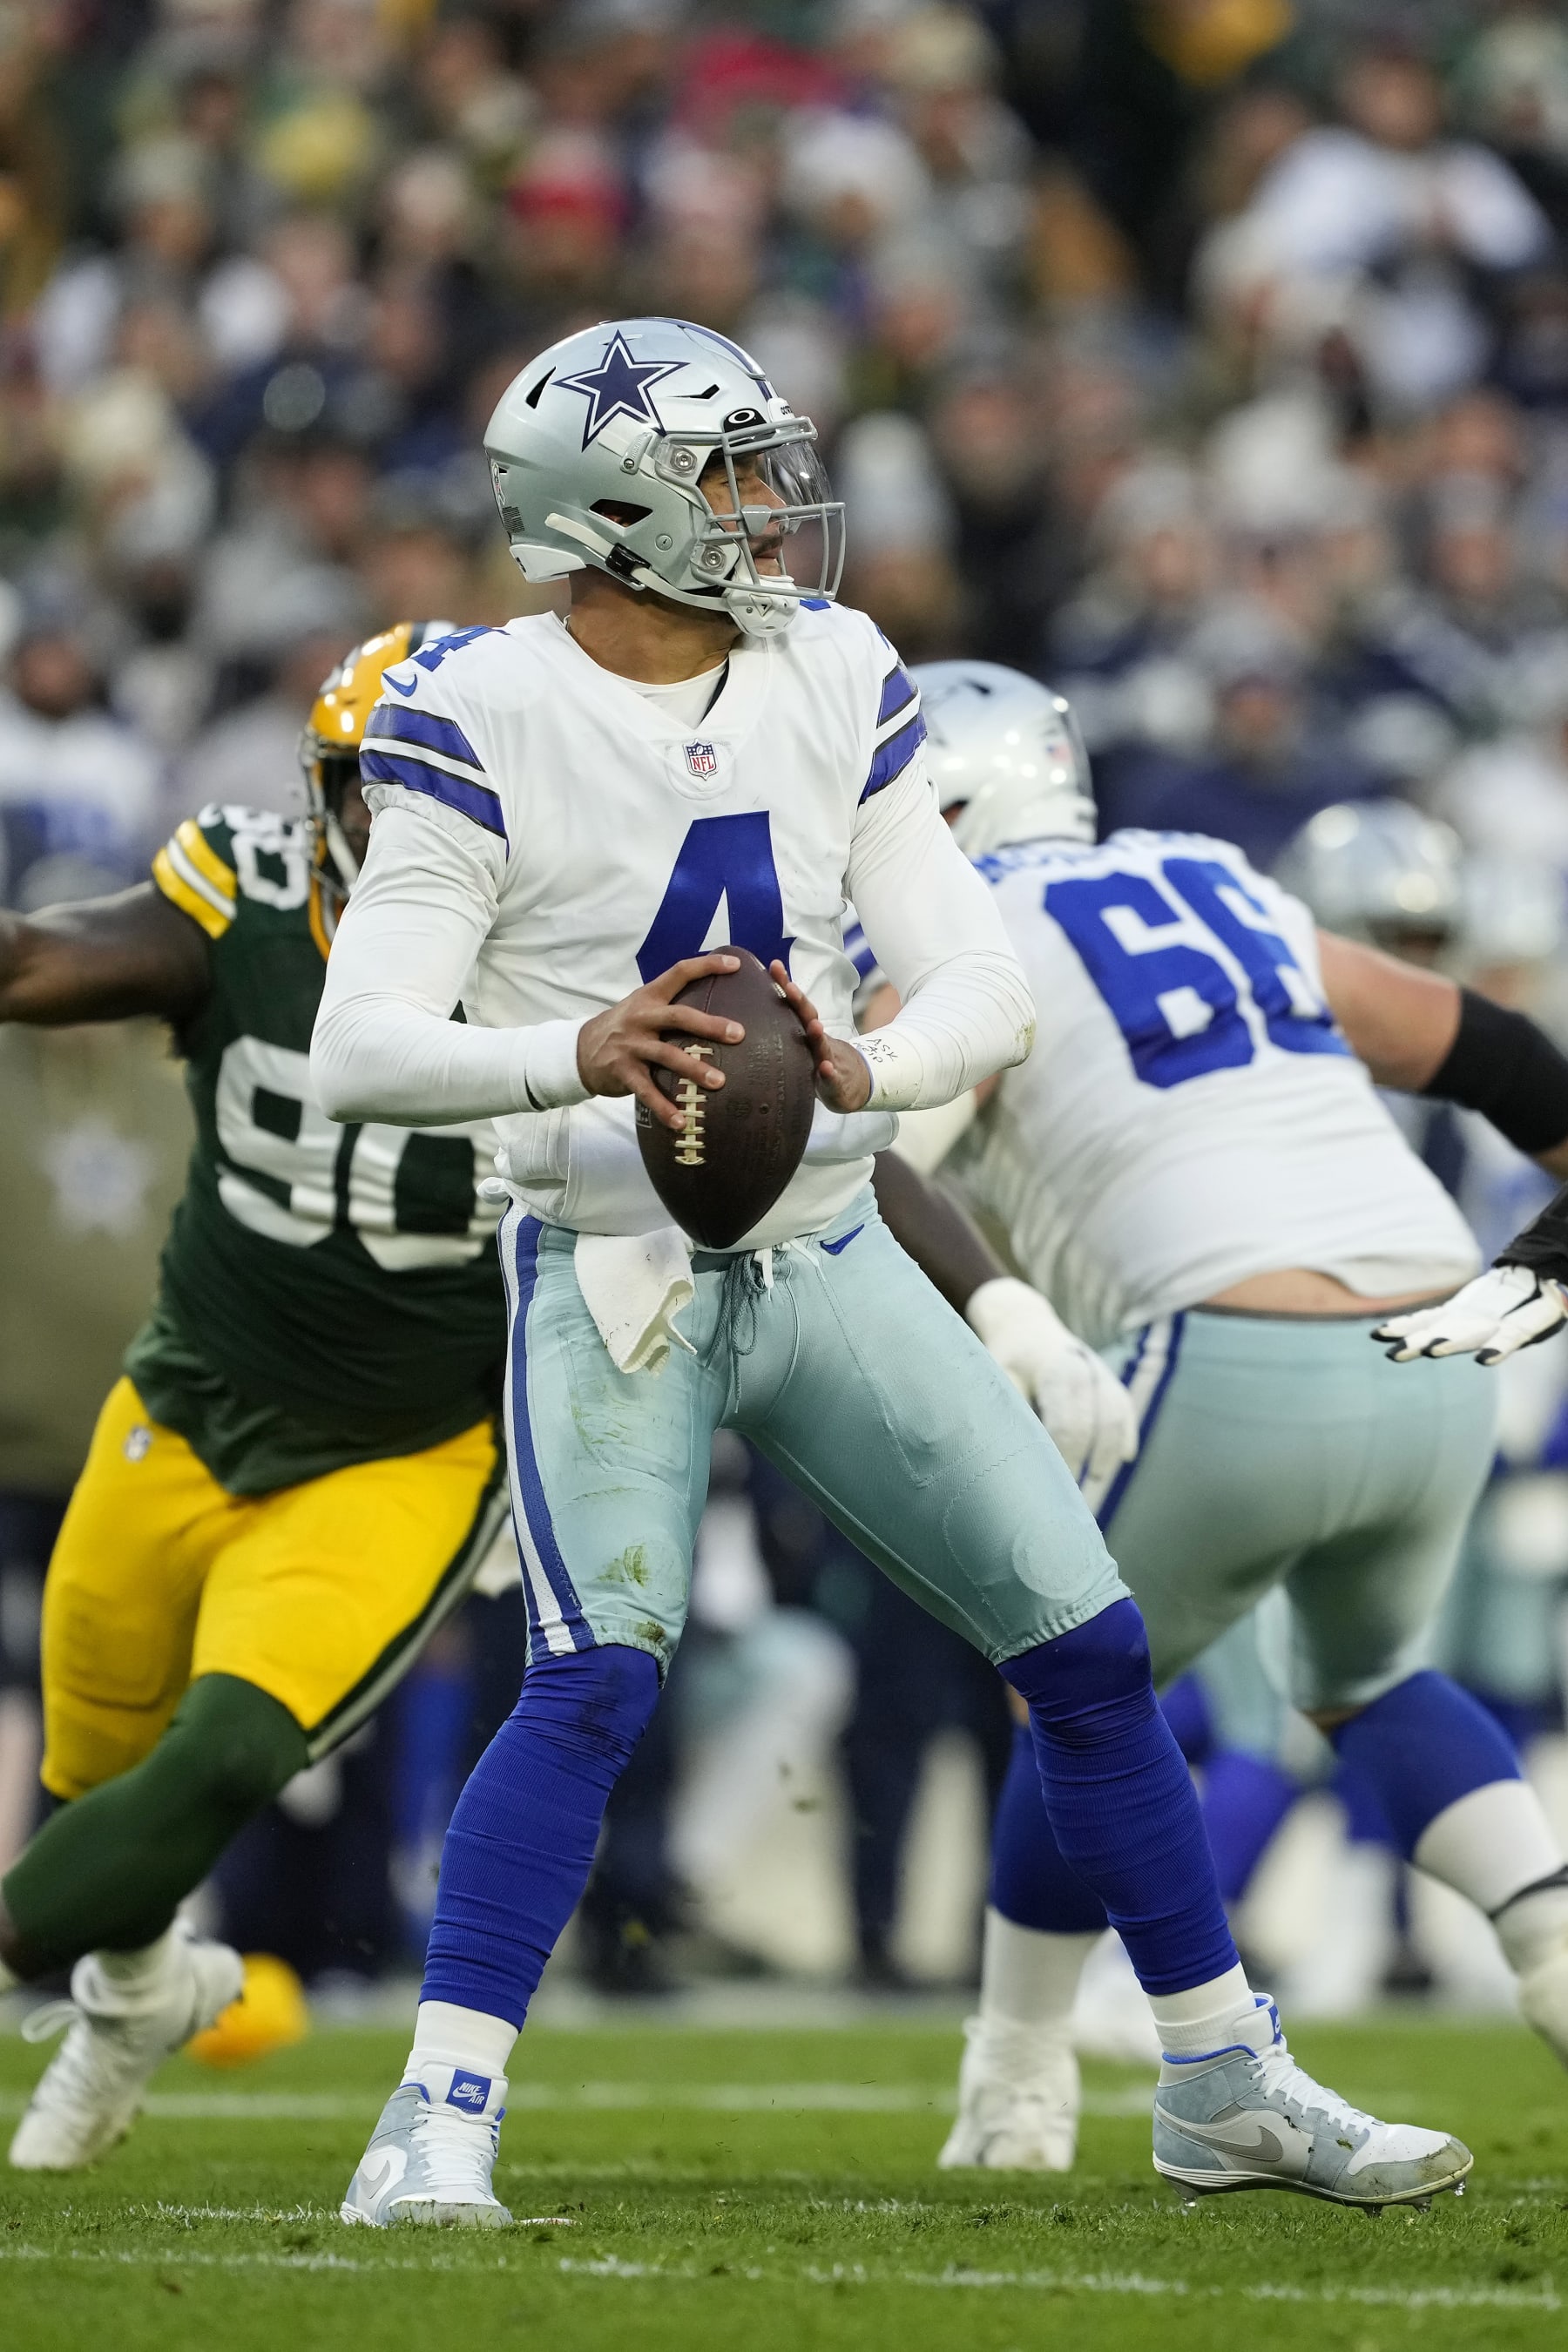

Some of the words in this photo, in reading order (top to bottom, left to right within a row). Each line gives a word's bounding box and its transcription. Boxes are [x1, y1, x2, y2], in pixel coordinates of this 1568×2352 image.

[409, 625, 511, 672] 4
[692, 755, 714, 772] NFL
[635, 810, 798, 985] 4
[214, 1034, 502, 1271] 90
[458, 2082, 482, 2093] NIKE
[468, 2094, 485, 2105] AIR
